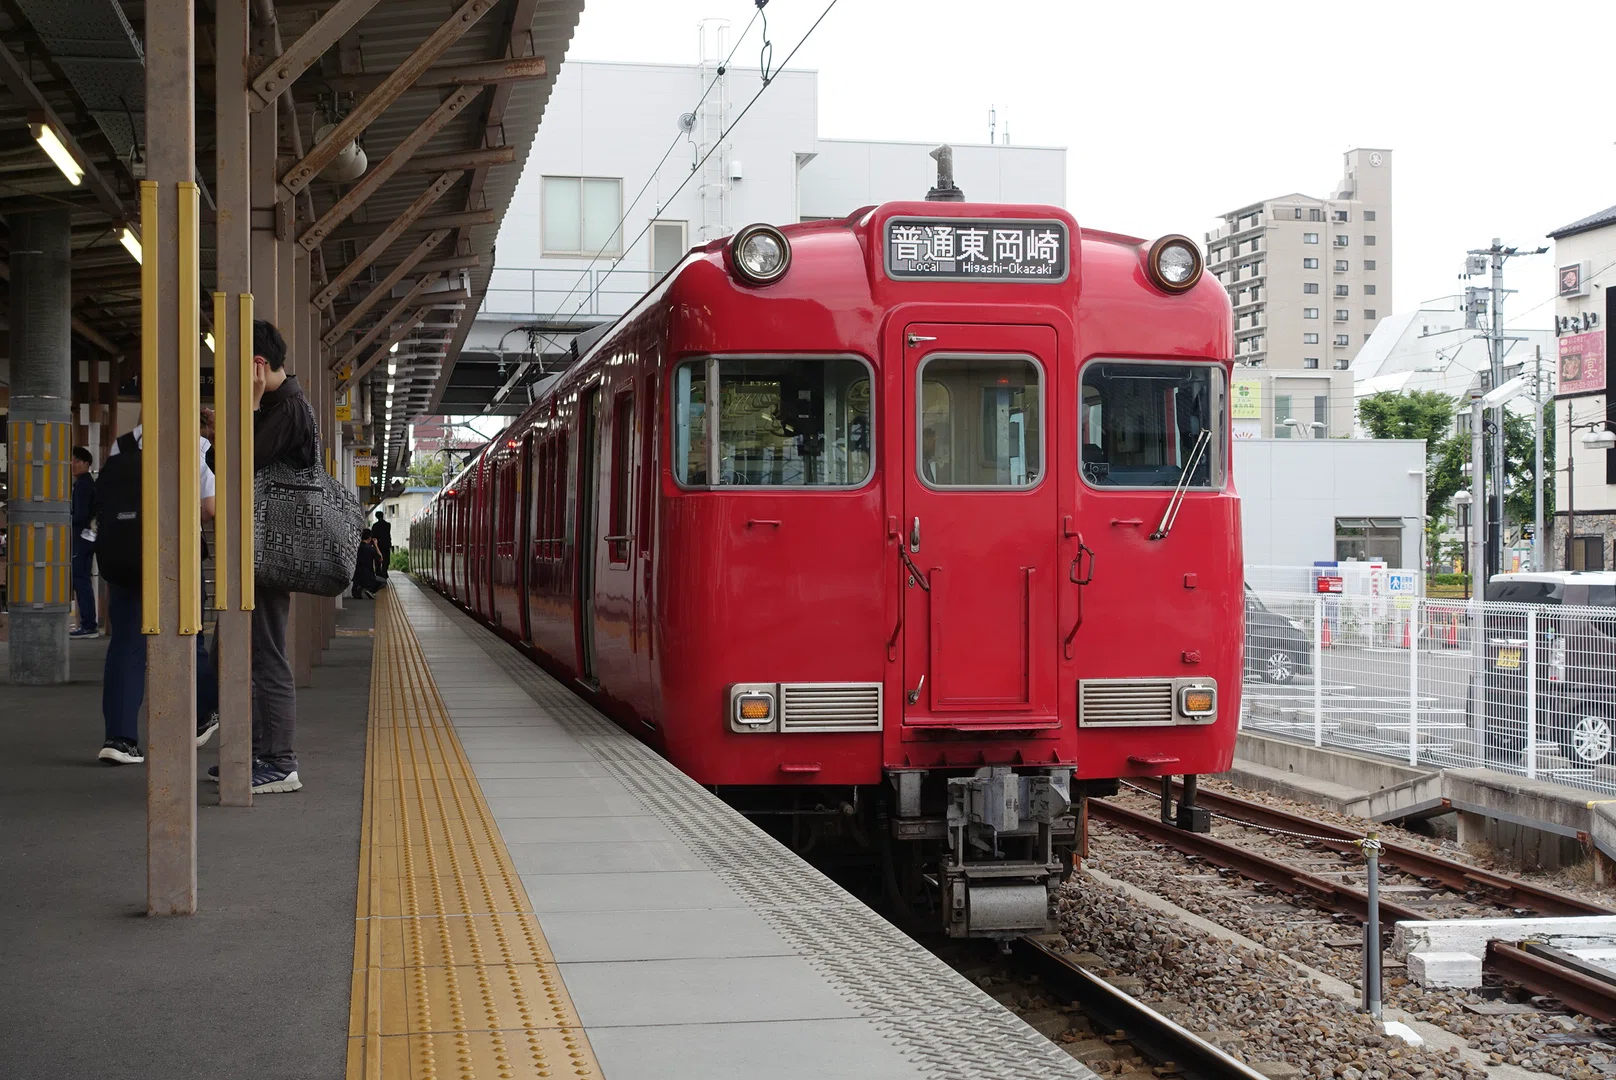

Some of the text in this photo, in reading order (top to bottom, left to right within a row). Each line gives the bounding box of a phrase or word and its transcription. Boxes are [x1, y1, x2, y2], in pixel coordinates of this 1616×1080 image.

[891, 226, 1060, 264] 普通 東岡崎
[908, 260, 1052, 275] Local Higashi-Okazaki
[1555, 312, 1597, 337] いこい
